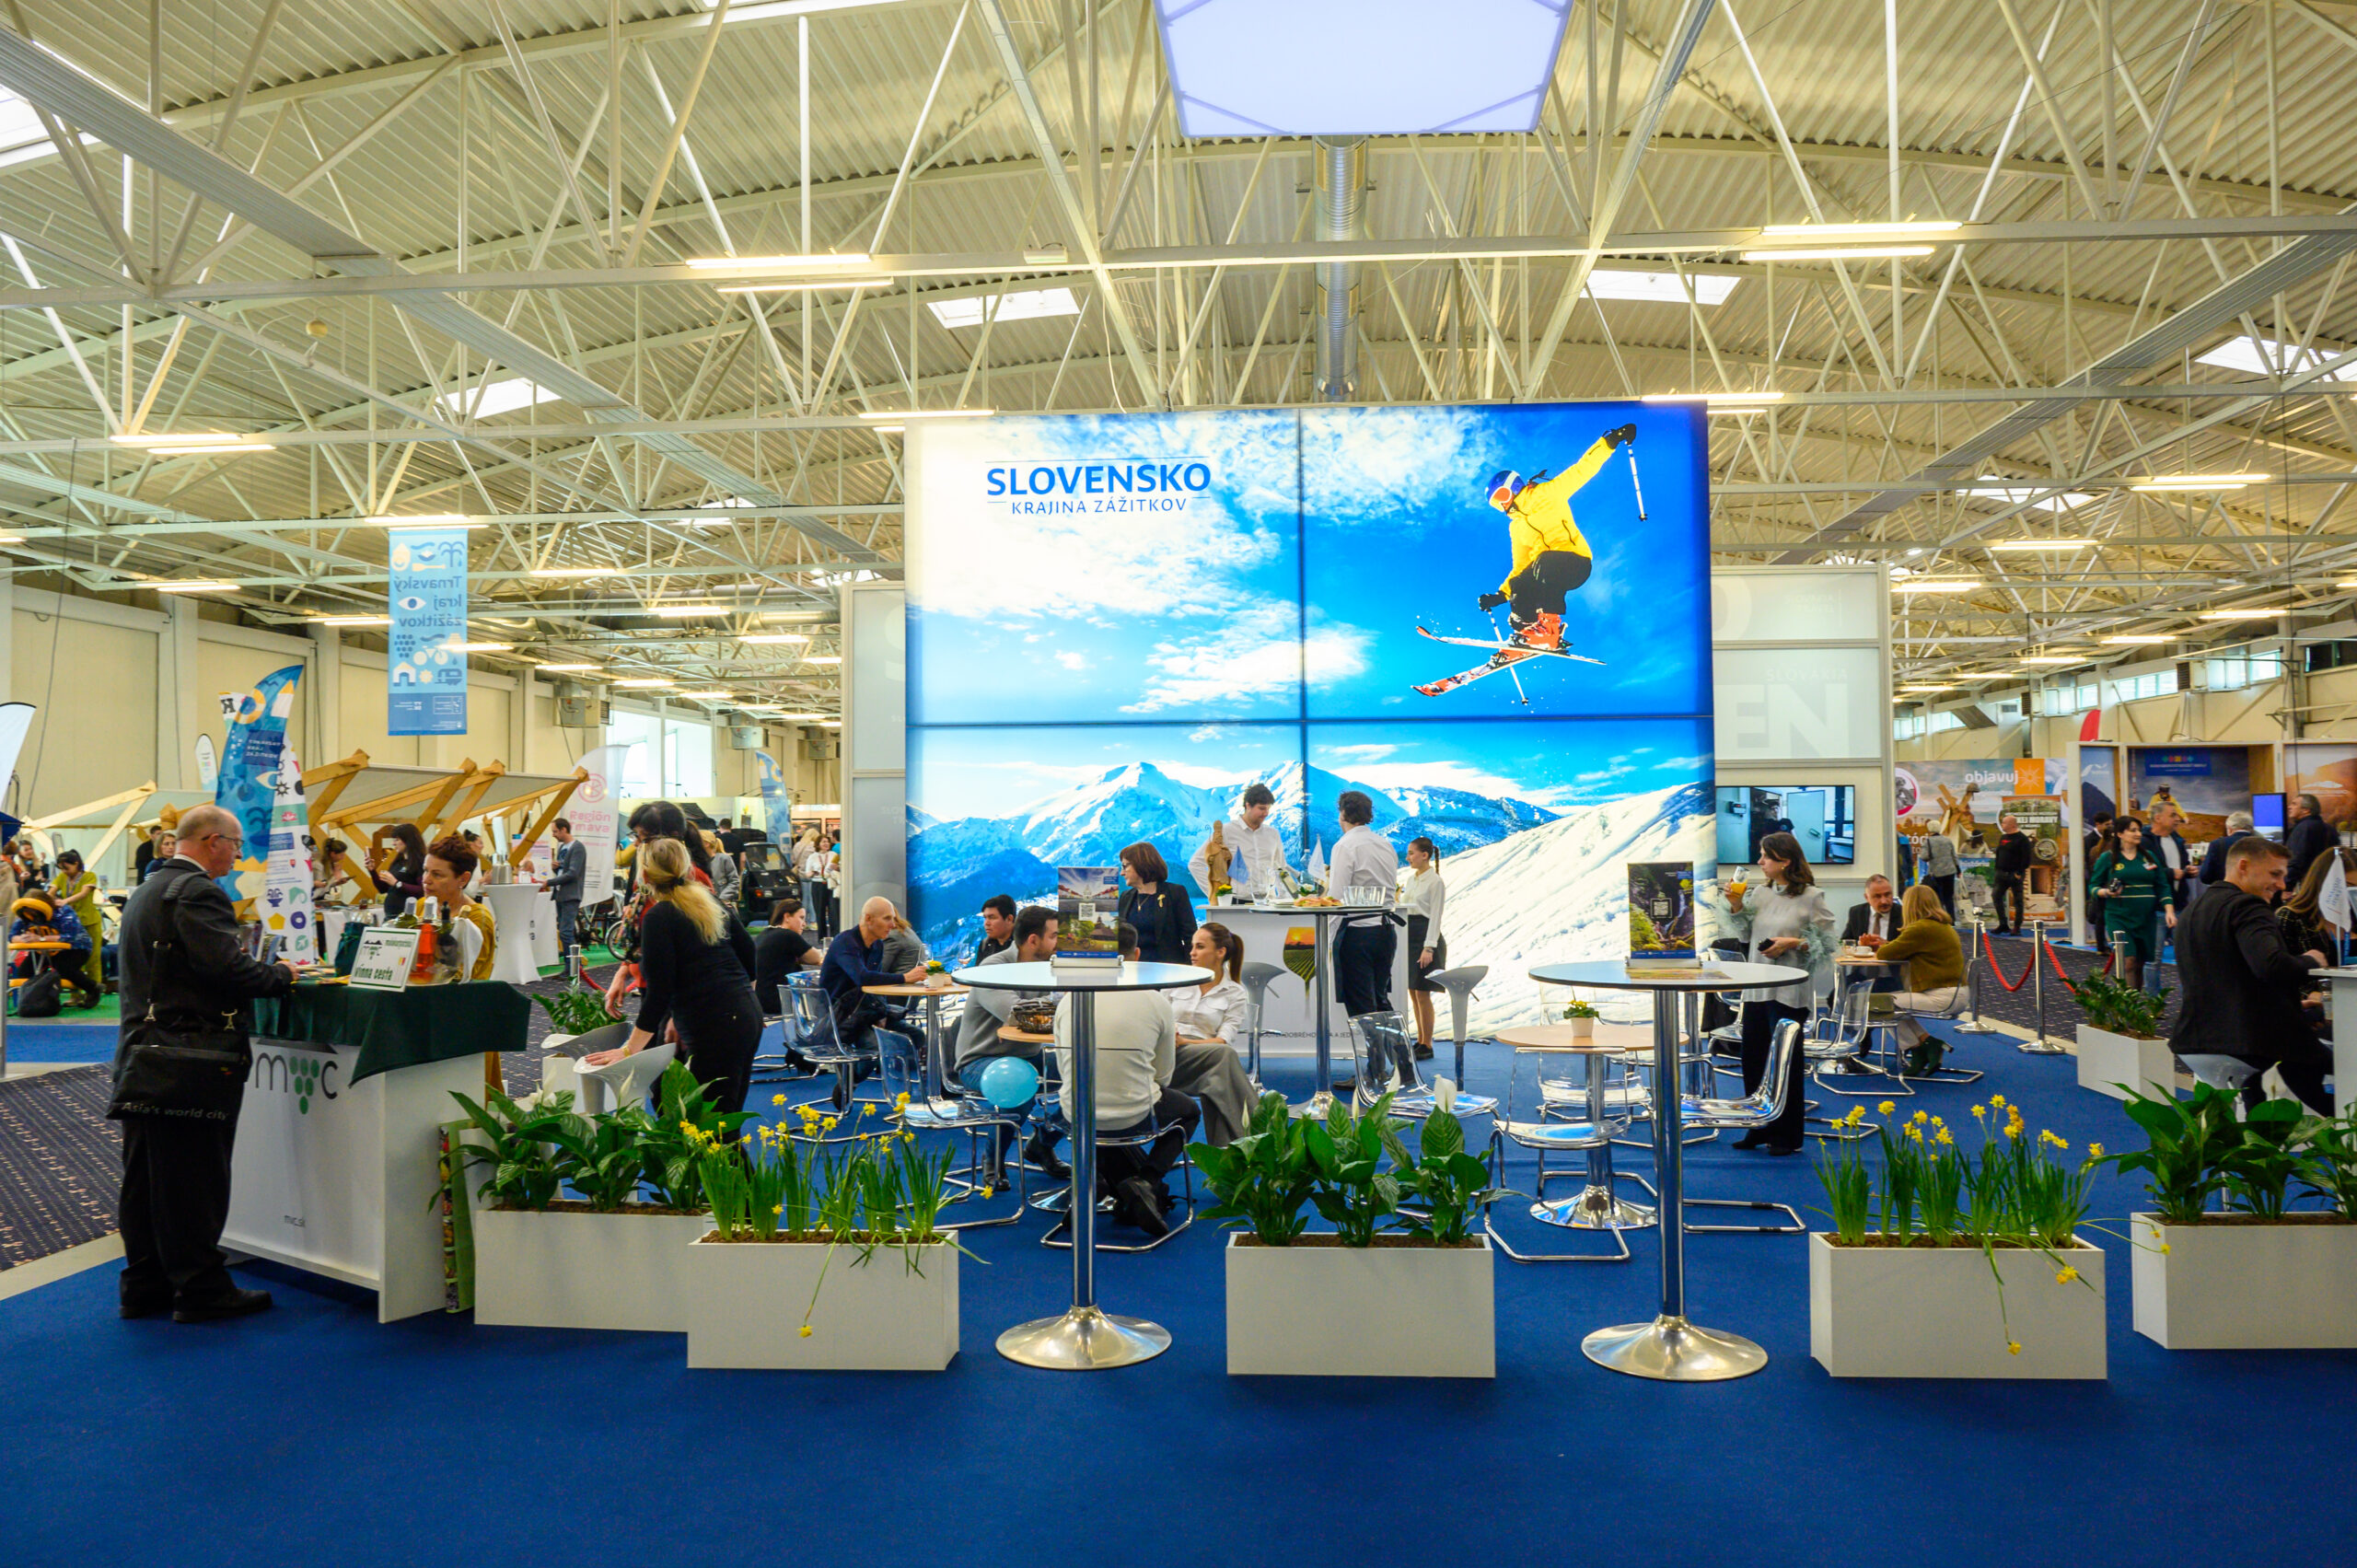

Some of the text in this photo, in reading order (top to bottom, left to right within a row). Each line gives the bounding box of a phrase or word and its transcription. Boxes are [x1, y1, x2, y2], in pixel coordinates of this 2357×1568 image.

[986, 462, 1212, 496] SLOVENSKO
[1012, 496, 1187, 515] KRAJINA ZÁŽITKOV
[1965, 770, 2019, 785] objavuj
[121, 1102, 229, 1121] Asia's world city
